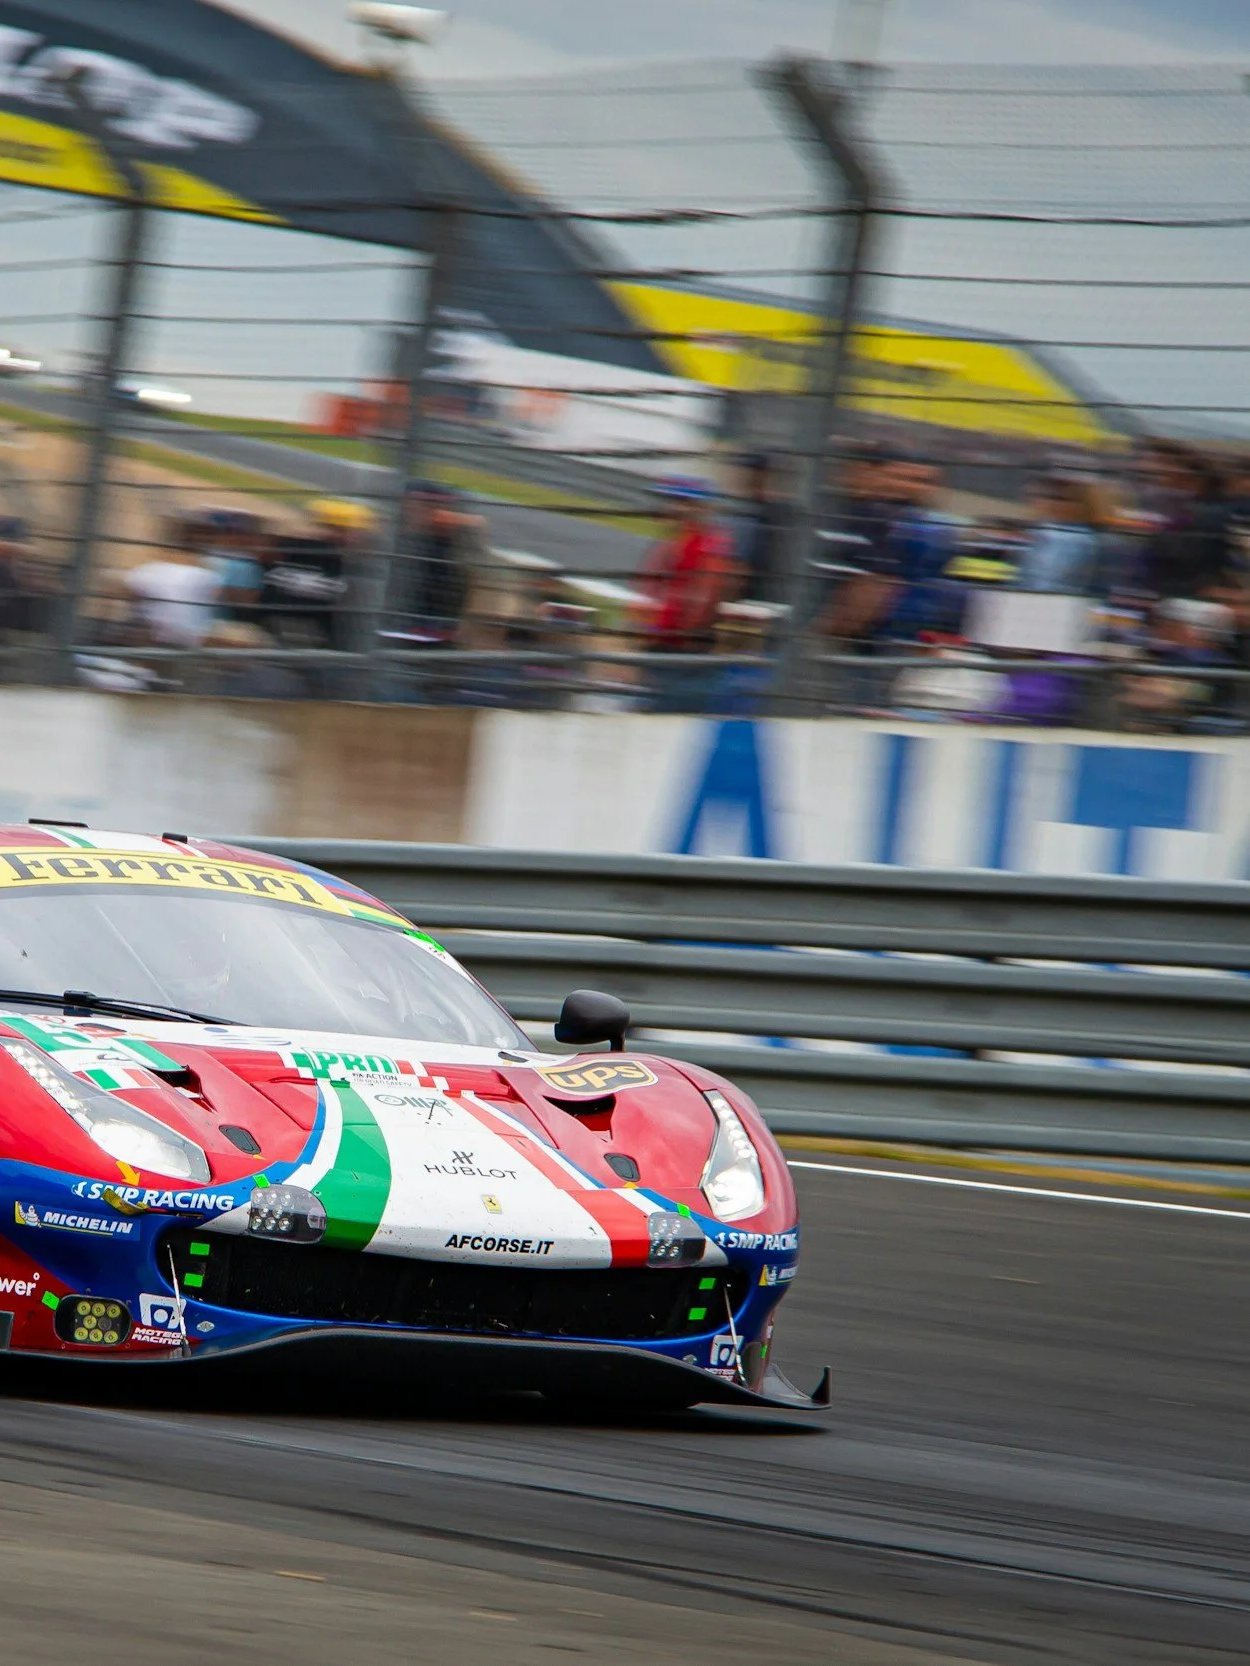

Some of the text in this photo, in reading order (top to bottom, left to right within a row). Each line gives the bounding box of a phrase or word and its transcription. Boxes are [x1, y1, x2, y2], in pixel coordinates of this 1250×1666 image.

[313, 1051, 397, 1075] PRO
[548, 1065, 646, 1089] ups
[423, 1164, 518, 1180] HUBLOT
[142, 1191, 235, 1211] RACING
[42, 1211, 134, 1234] MICHELIN
[444, 1233, 555, 1255] AFCORSE.IT
[728, 1232, 764, 1250] SMP
